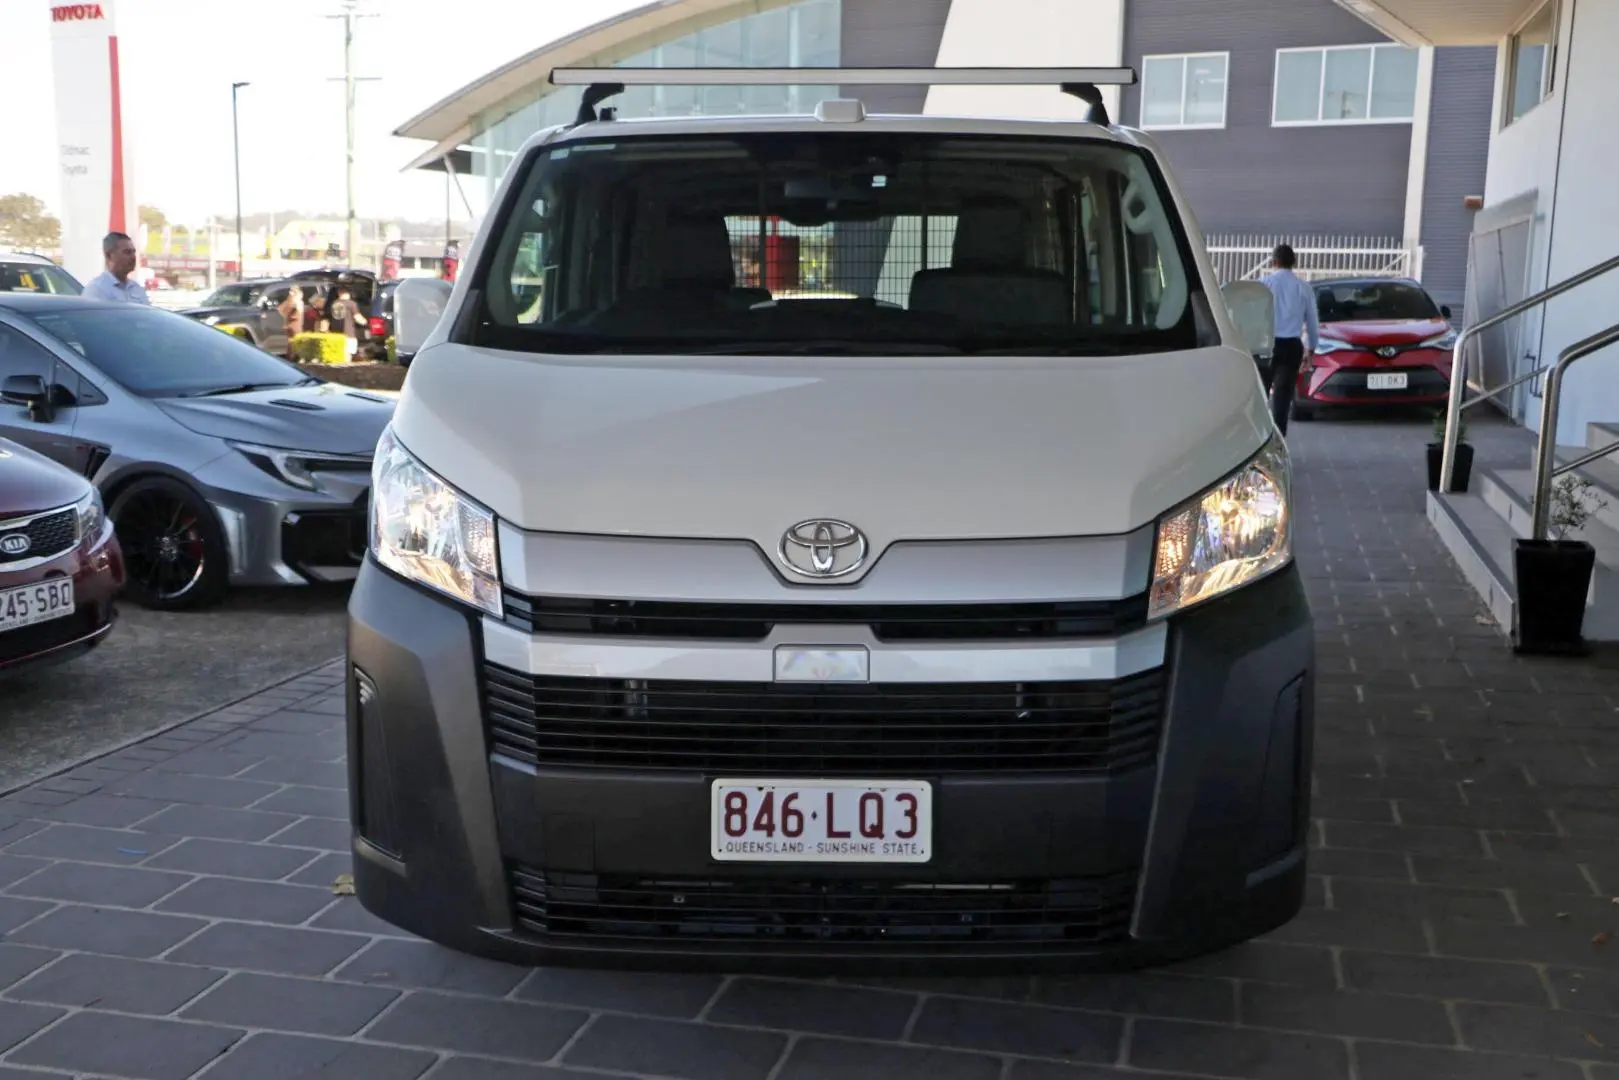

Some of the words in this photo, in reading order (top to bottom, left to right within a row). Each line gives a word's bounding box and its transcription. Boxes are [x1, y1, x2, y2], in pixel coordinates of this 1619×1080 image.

[51, 4, 104, 22] TOYOTA
[4, 538, 28, 551] KIA
[724, 791, 804, 838] 846
[826, 792, 918, 839] LQ3
[725, 842, 804, 853] QUEENSLAND
[816, 842, 876, 854] SUNSHINE
[882, 842, 918, 854] STATE
